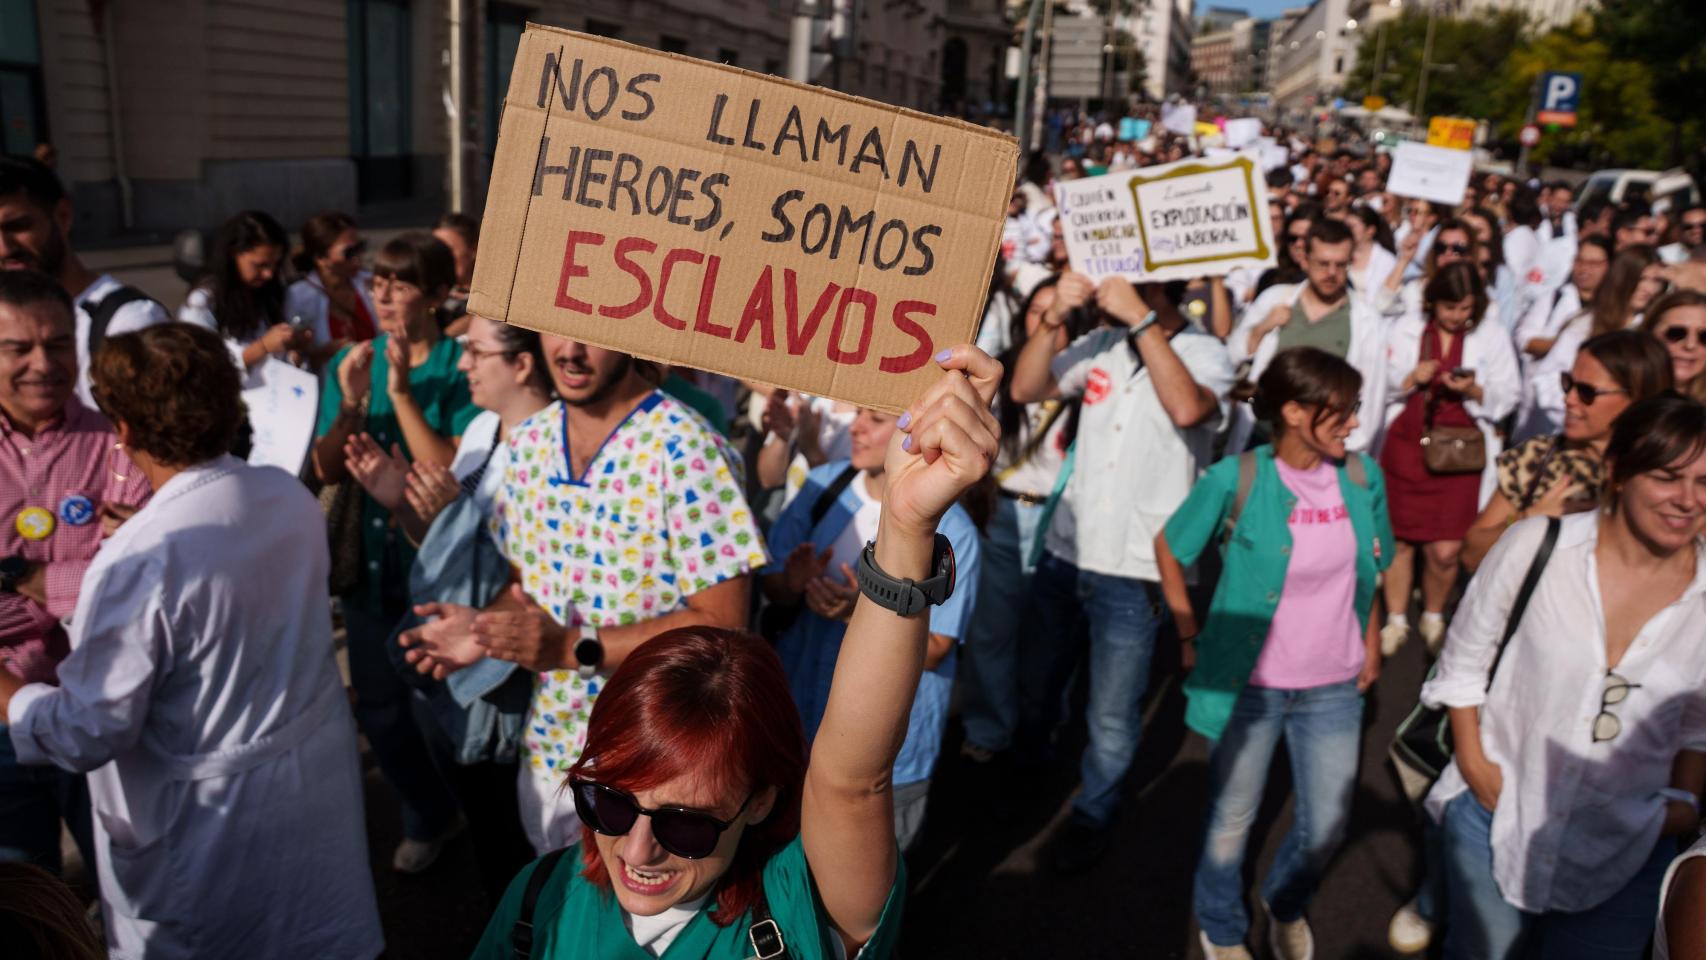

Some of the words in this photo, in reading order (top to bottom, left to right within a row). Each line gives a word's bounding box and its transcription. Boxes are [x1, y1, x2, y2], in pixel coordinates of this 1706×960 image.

[536, 51, 661, 122] NOS
[706, 93, 942, 193] LLAMAN
[1544, 75, 1576, 110] P
[532, 135, 735, 241] HEROES,
[761, 190, 942, 276] SOMOS
[1150, 196, 1248, 230] EXPLOTACIÓN
[1174, 227, 1238, 250] LABORAL
[554, 230, 937, 374] ESCLAVOS
